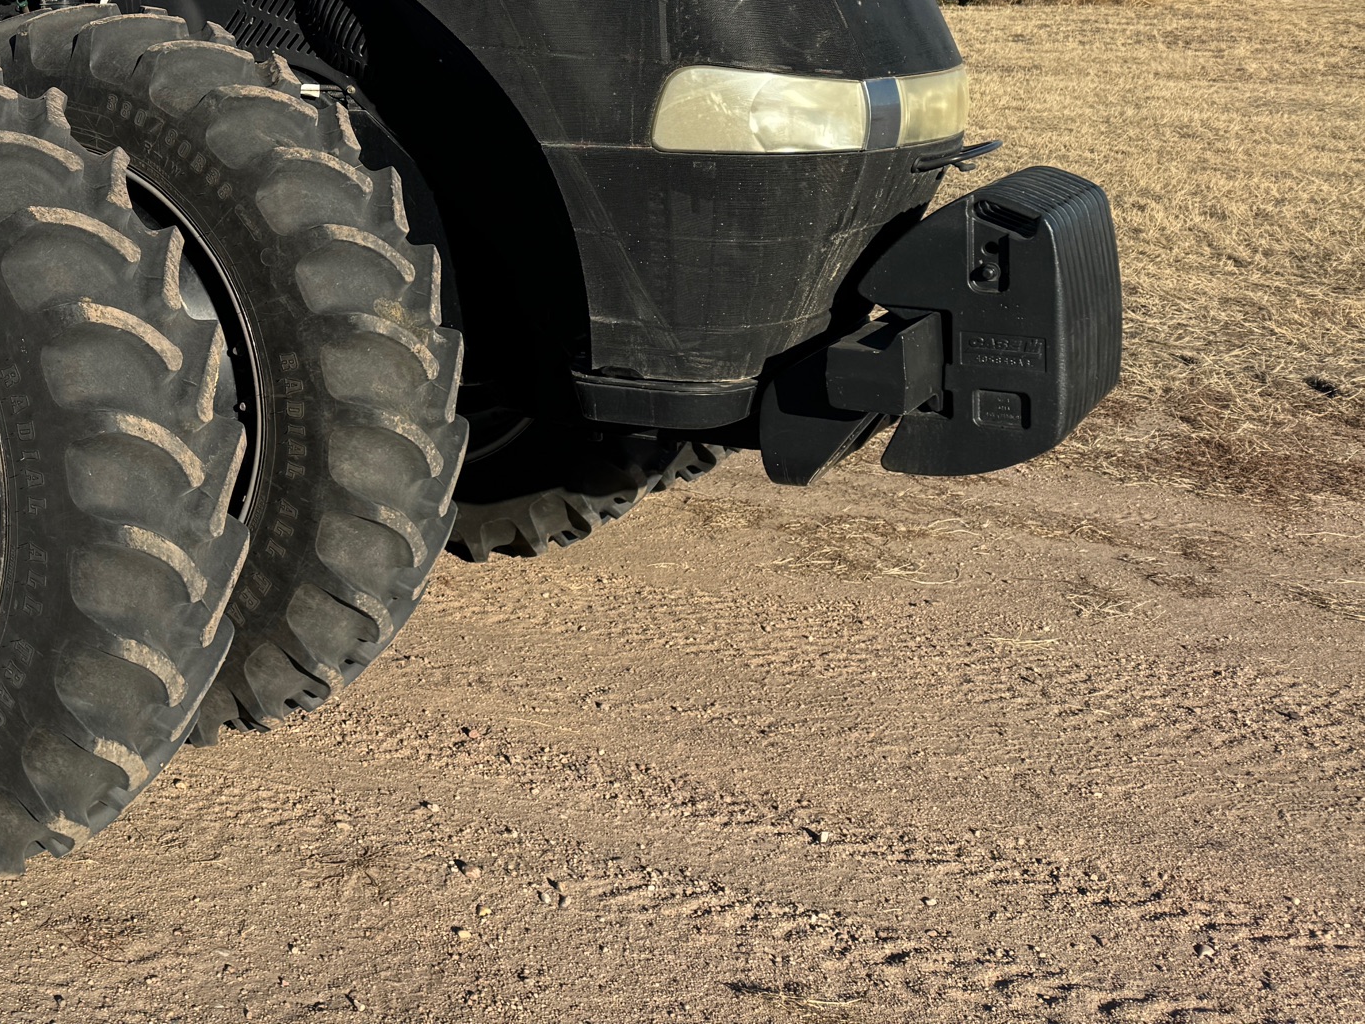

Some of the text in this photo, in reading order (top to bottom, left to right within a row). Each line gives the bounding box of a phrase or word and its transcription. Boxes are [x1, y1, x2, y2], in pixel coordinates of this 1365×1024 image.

[106, 93, 233, 200] 380/80R38
[0, 363, 47, 516] RADIAL
[279, 351, 307, 481] RADIAL
[22, 541, 49, 617] ALL
[265, 496, 299, 560] ALL
